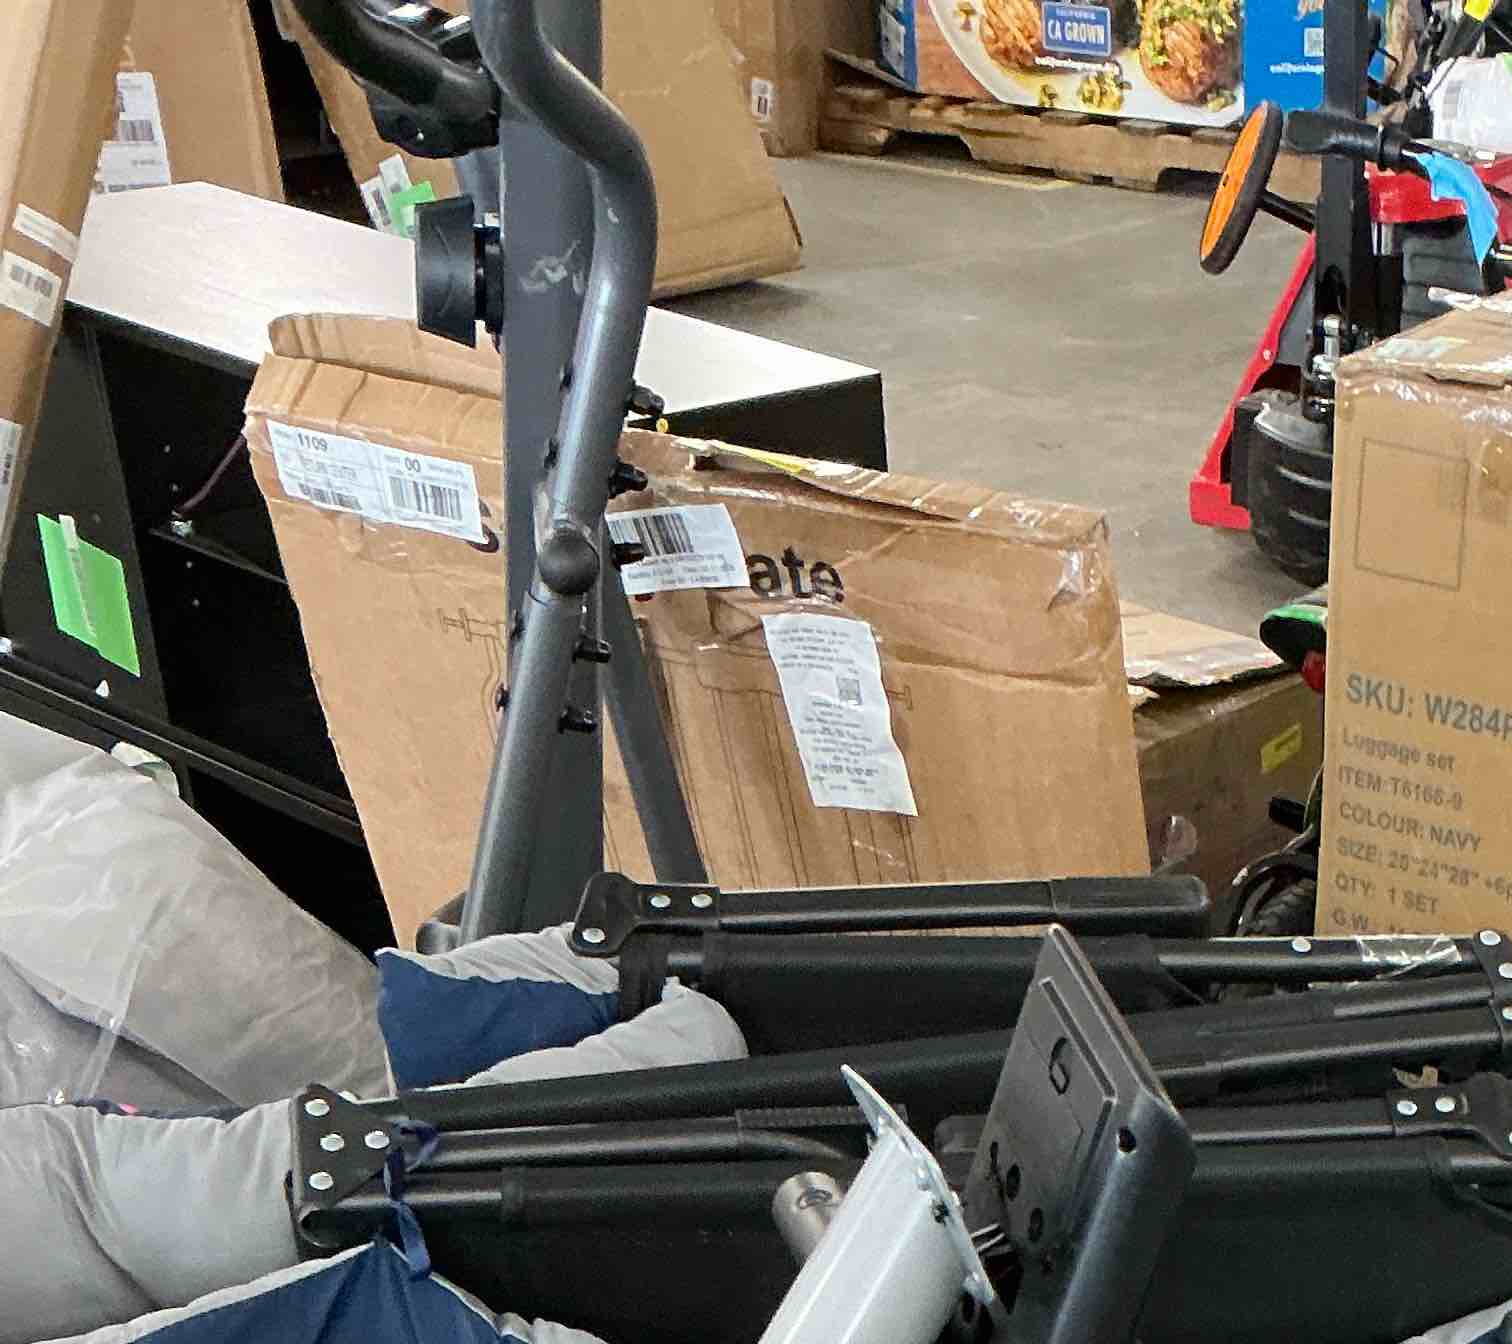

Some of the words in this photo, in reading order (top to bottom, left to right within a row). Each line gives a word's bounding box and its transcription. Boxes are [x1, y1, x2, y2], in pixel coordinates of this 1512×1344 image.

[1047, 19, 1062, 41] CA
[1064, 21, 1105, 45] GROWN
[297, 433, 328, 452] 1109
[1346, 672, 1414, 719] SKU:
[1343, 728, 1420, 766] Luggage
[1427, 750, 1456, 773] set
[1339, 800, 1424, 840] COLOUR:
[1430, 824, 1481, 852] NAVY
[1336, 836, 1383, 866] SIZE:
[1335, 871, 1376, 897] QTY:
[1402, 889, 1439, 915] SET
